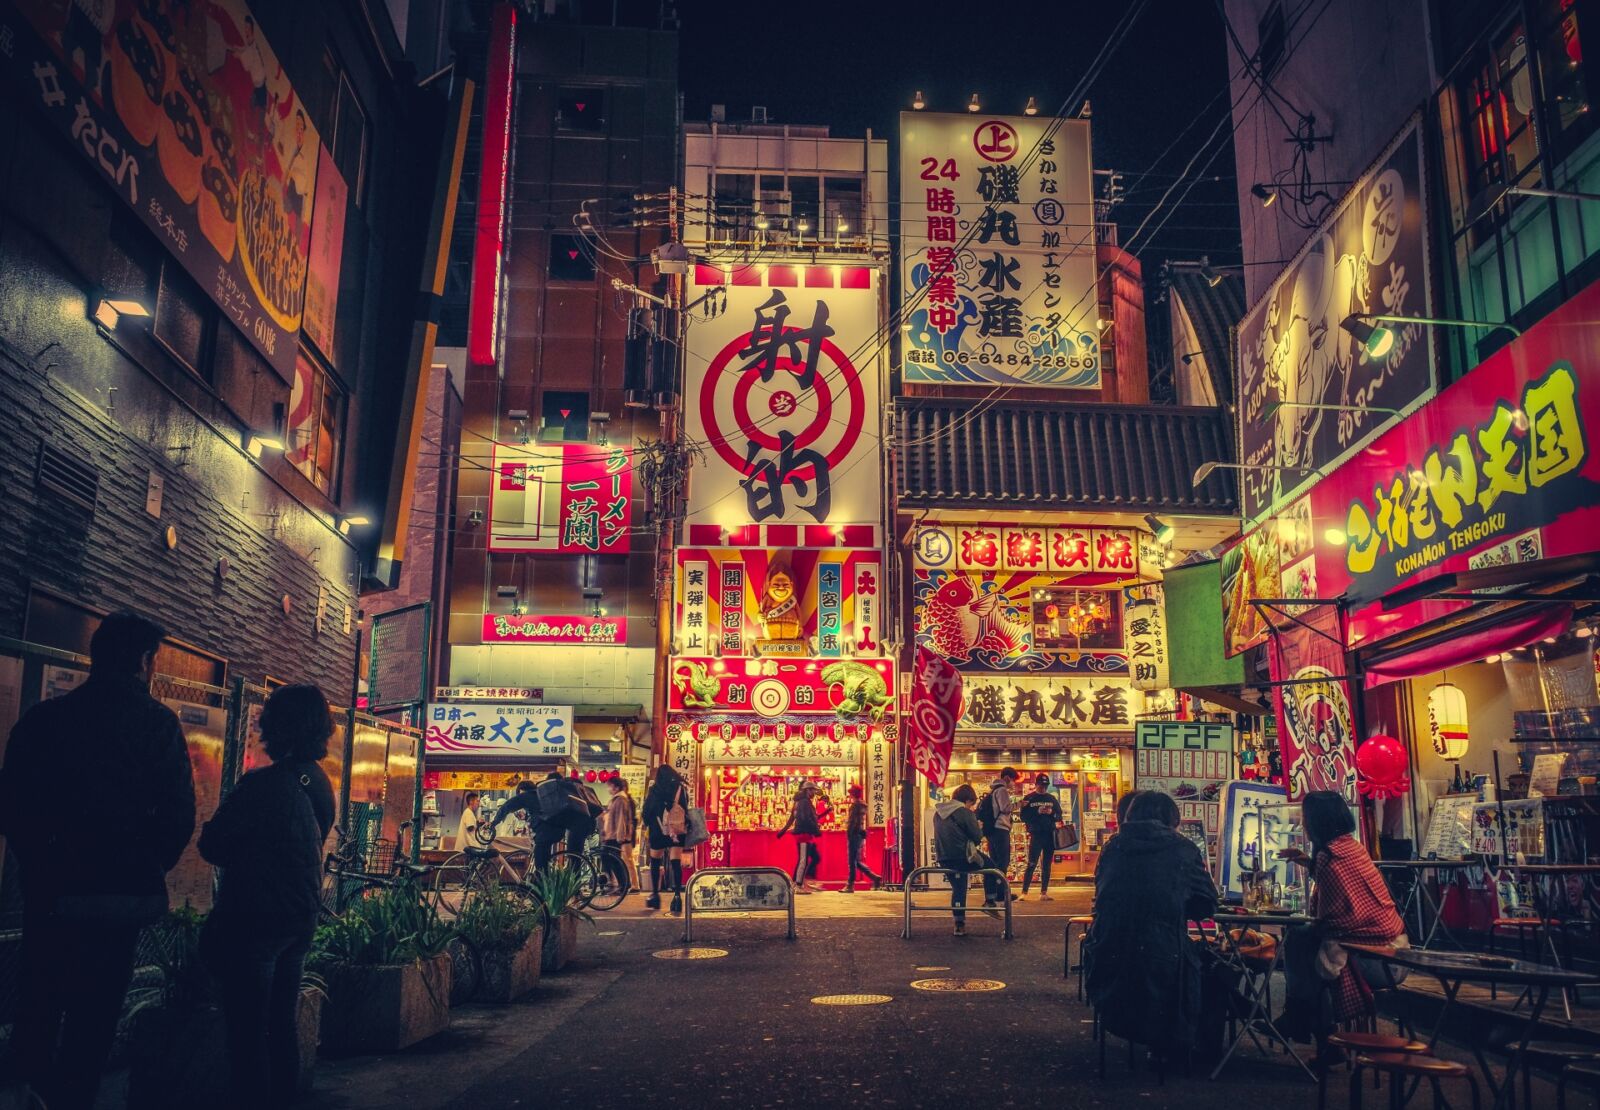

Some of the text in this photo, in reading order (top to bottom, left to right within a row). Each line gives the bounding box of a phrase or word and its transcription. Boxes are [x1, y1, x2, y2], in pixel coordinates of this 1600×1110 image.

[920, 157, 960, 334] 24時間営業中
[975, 164, 1025, 338] 磯丸水産
[907, 349, 1094, 369] 電話 06-6484-2850
[737, 288, 836, 524] 射的
[527, 464, 545, 473] 入口
[562, 481, 600, 551] 一蘭
[600, 447, 628, 548] ラーメン
[961, 529, 1134, 569] 海鮮浜焼
[1395, 541, 1446, 577] KONAMON
[1448, 512, 1506, 551] TENGOKU
[687, 569, 704, 649] 実弾禁止
[723, 569, 741, 650] 開運招福
[821, 570, 839, 650] 千客万来
[1130, 617, 1157, 681] 愛之助
[432, 707, 559, 721] 日本一 創業昭和47年
[728, 685, 813, 704] 射 的
[967, 684, 1129, 725] 磯丸水産
[453, 717, 566, 744] 本家 大たこ
[667, 724, 682, 739] 祭
[883, 724, 899, 738] 祭
[1143, 725, 1180, 748] 2F
[1184, 725, 1223, 749] 2F
